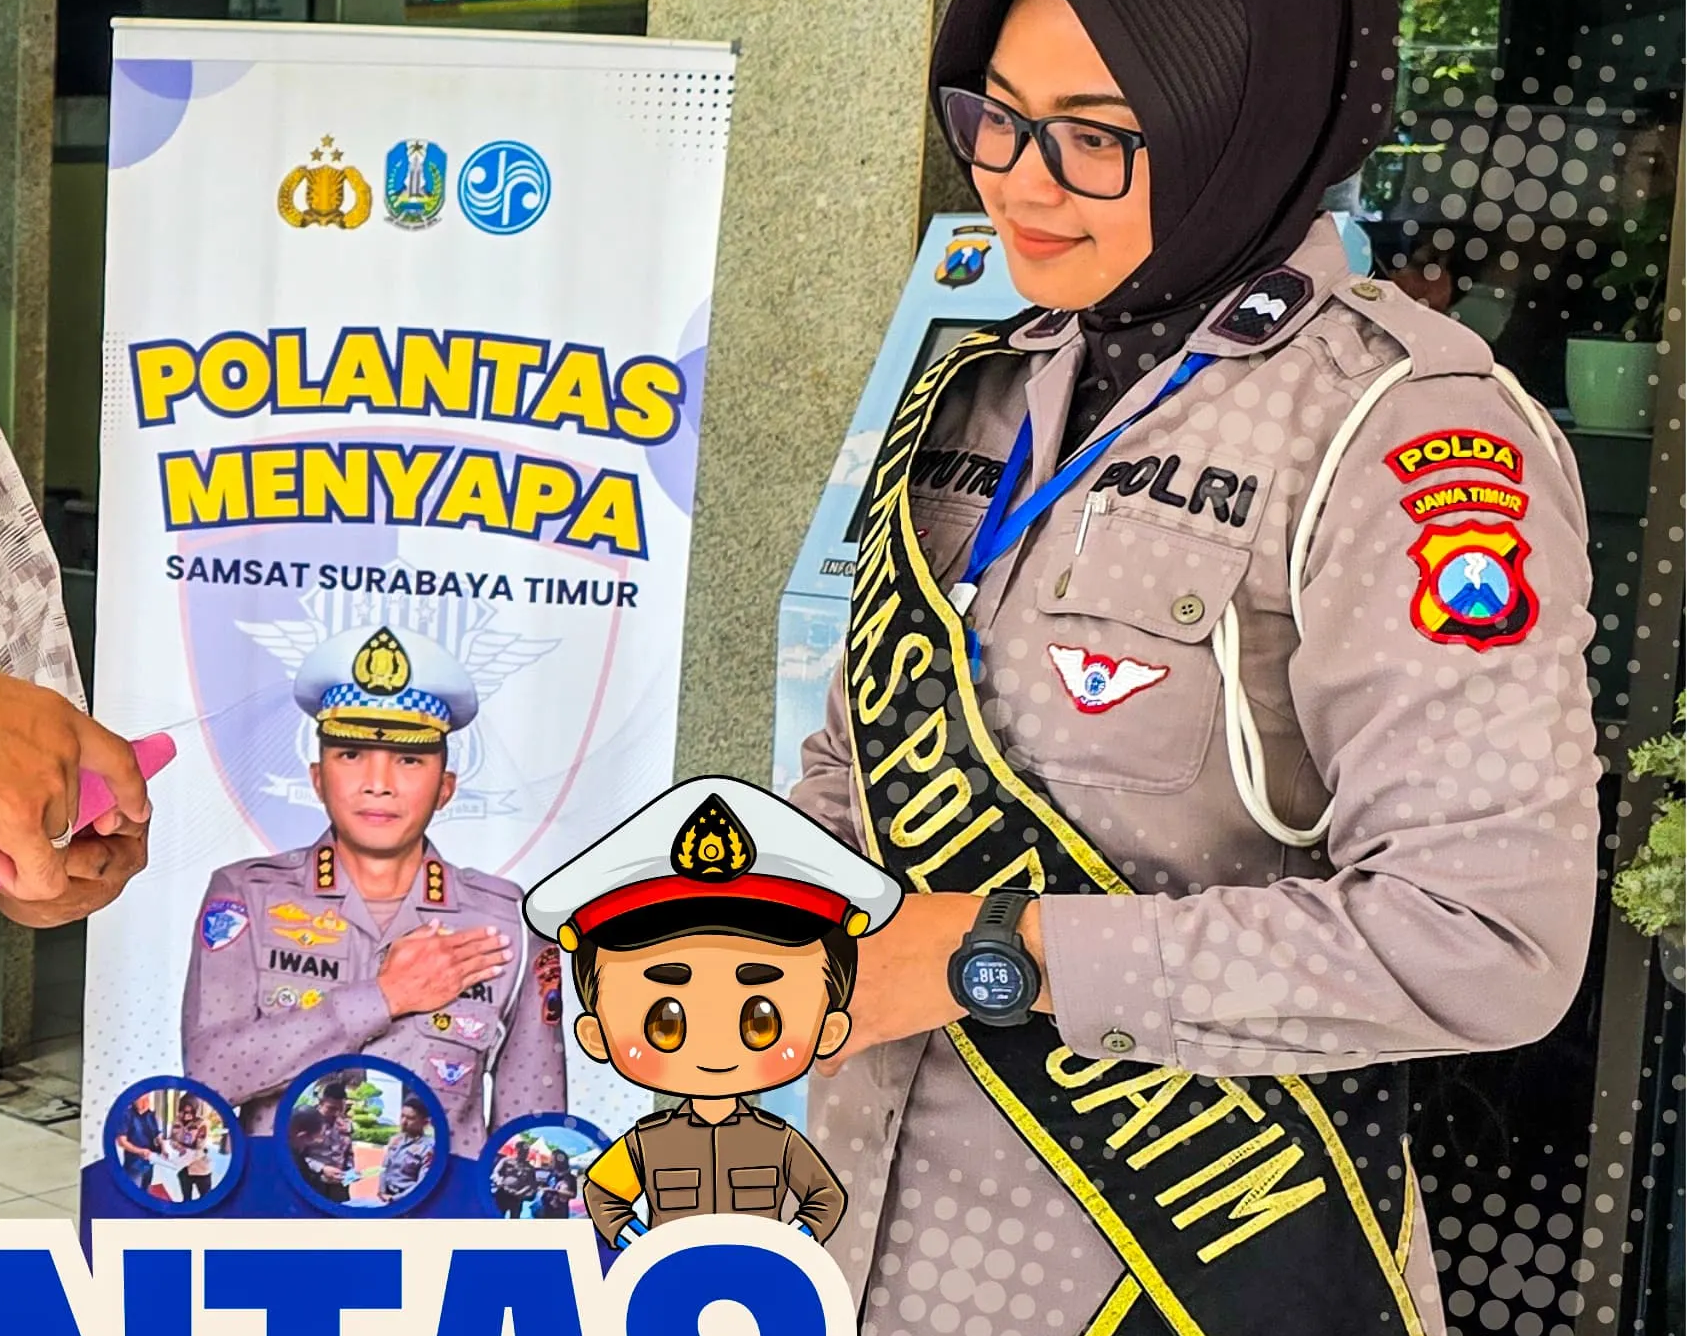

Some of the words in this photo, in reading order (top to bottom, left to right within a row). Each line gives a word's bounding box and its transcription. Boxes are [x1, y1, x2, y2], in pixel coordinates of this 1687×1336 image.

[132, 329, 685, 445] POLANTAS
[1399, 435, 1515, 473] POLDA
[160, 444, 648, 560] MENYAPA
[1092, 453, 1259, 529] POLRI
[1415, 490, 1468, 516] JAWA
[1469, 485, 1523, 513] TIMUR
[165, 554, 310, 590] SAMSAT
[318, 563, 515, 604] SURABAYA
[523, 577, 640, 609] TIMUR
[268, 948, 340, 981] IWAN
